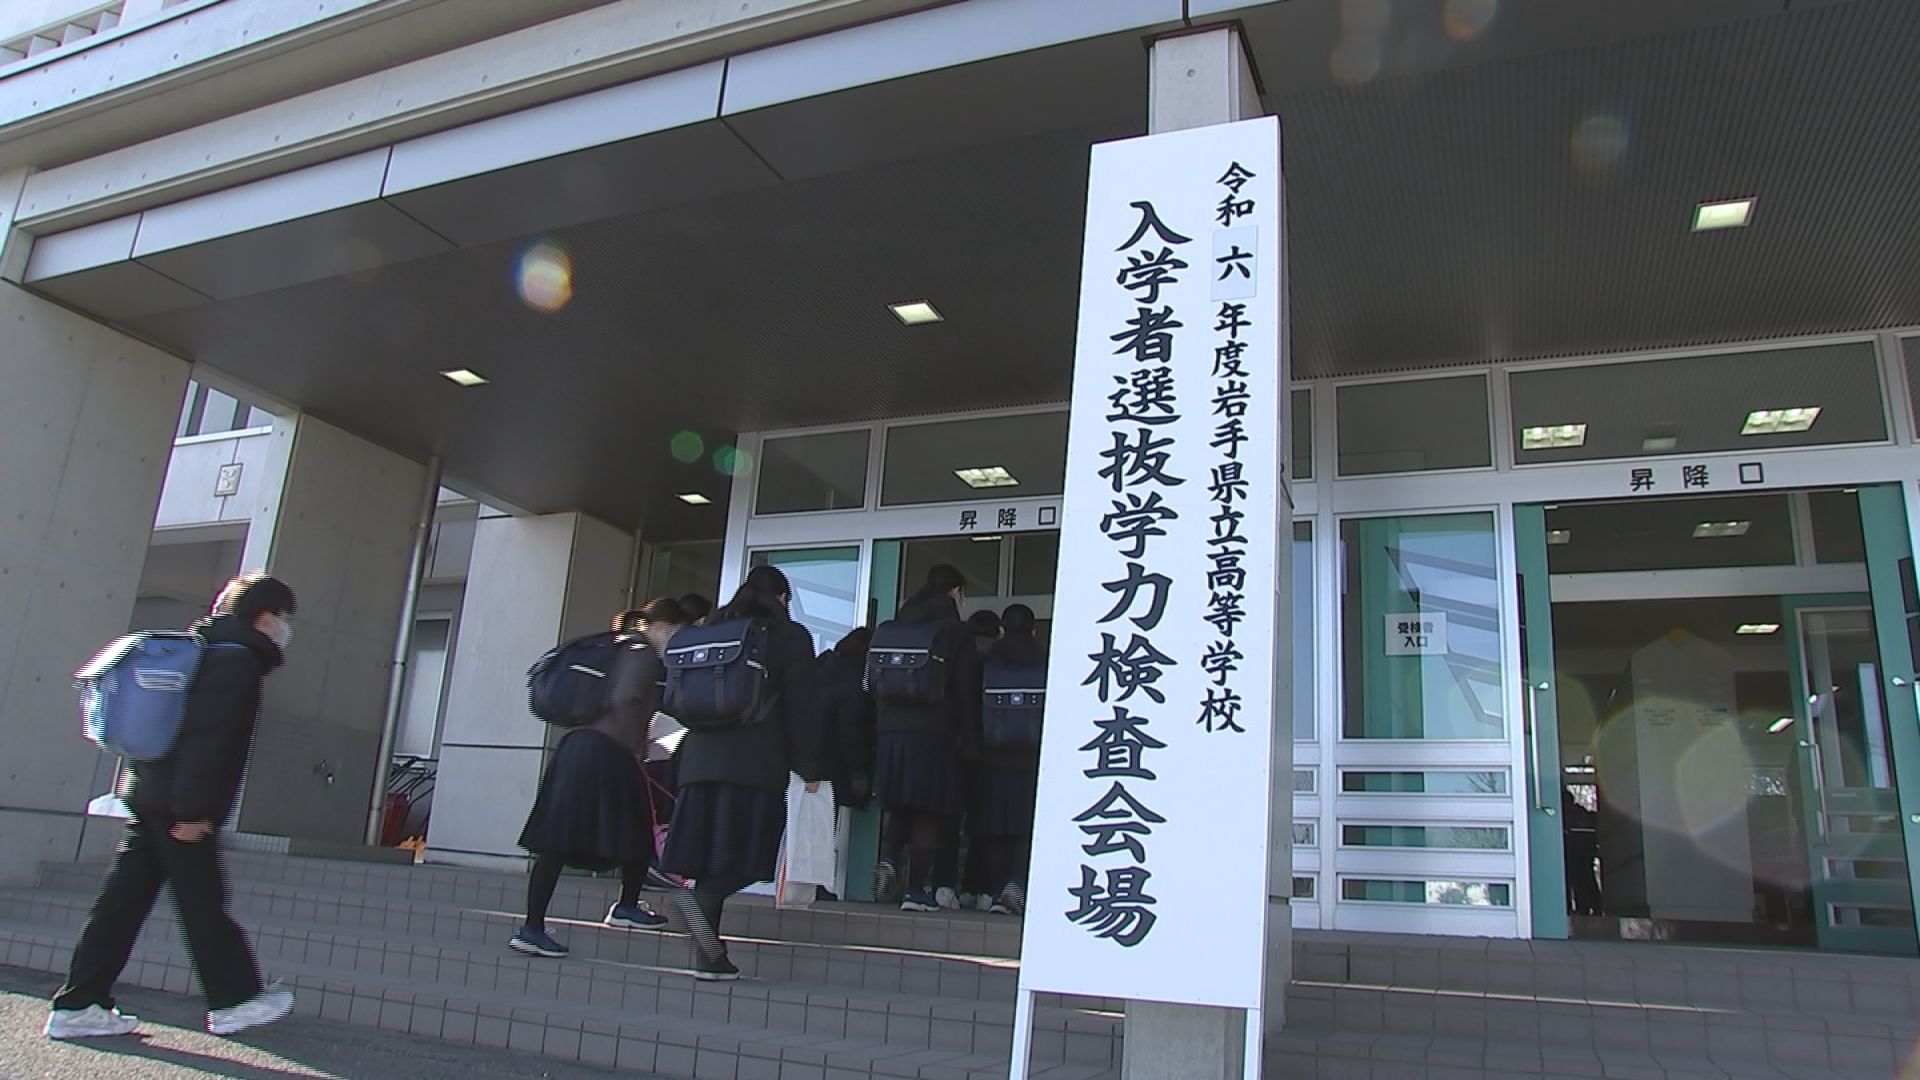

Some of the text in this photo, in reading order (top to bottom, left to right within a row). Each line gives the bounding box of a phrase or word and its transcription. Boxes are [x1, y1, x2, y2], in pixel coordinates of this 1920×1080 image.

[1630, 462, 1764, 492] 昇降口
[959, 506, 1057, 531] 昇降口
[1064, 200, 1193, 947] 入学者選抜学力検査会場
[1404, 636, 1428, 648] 入口
